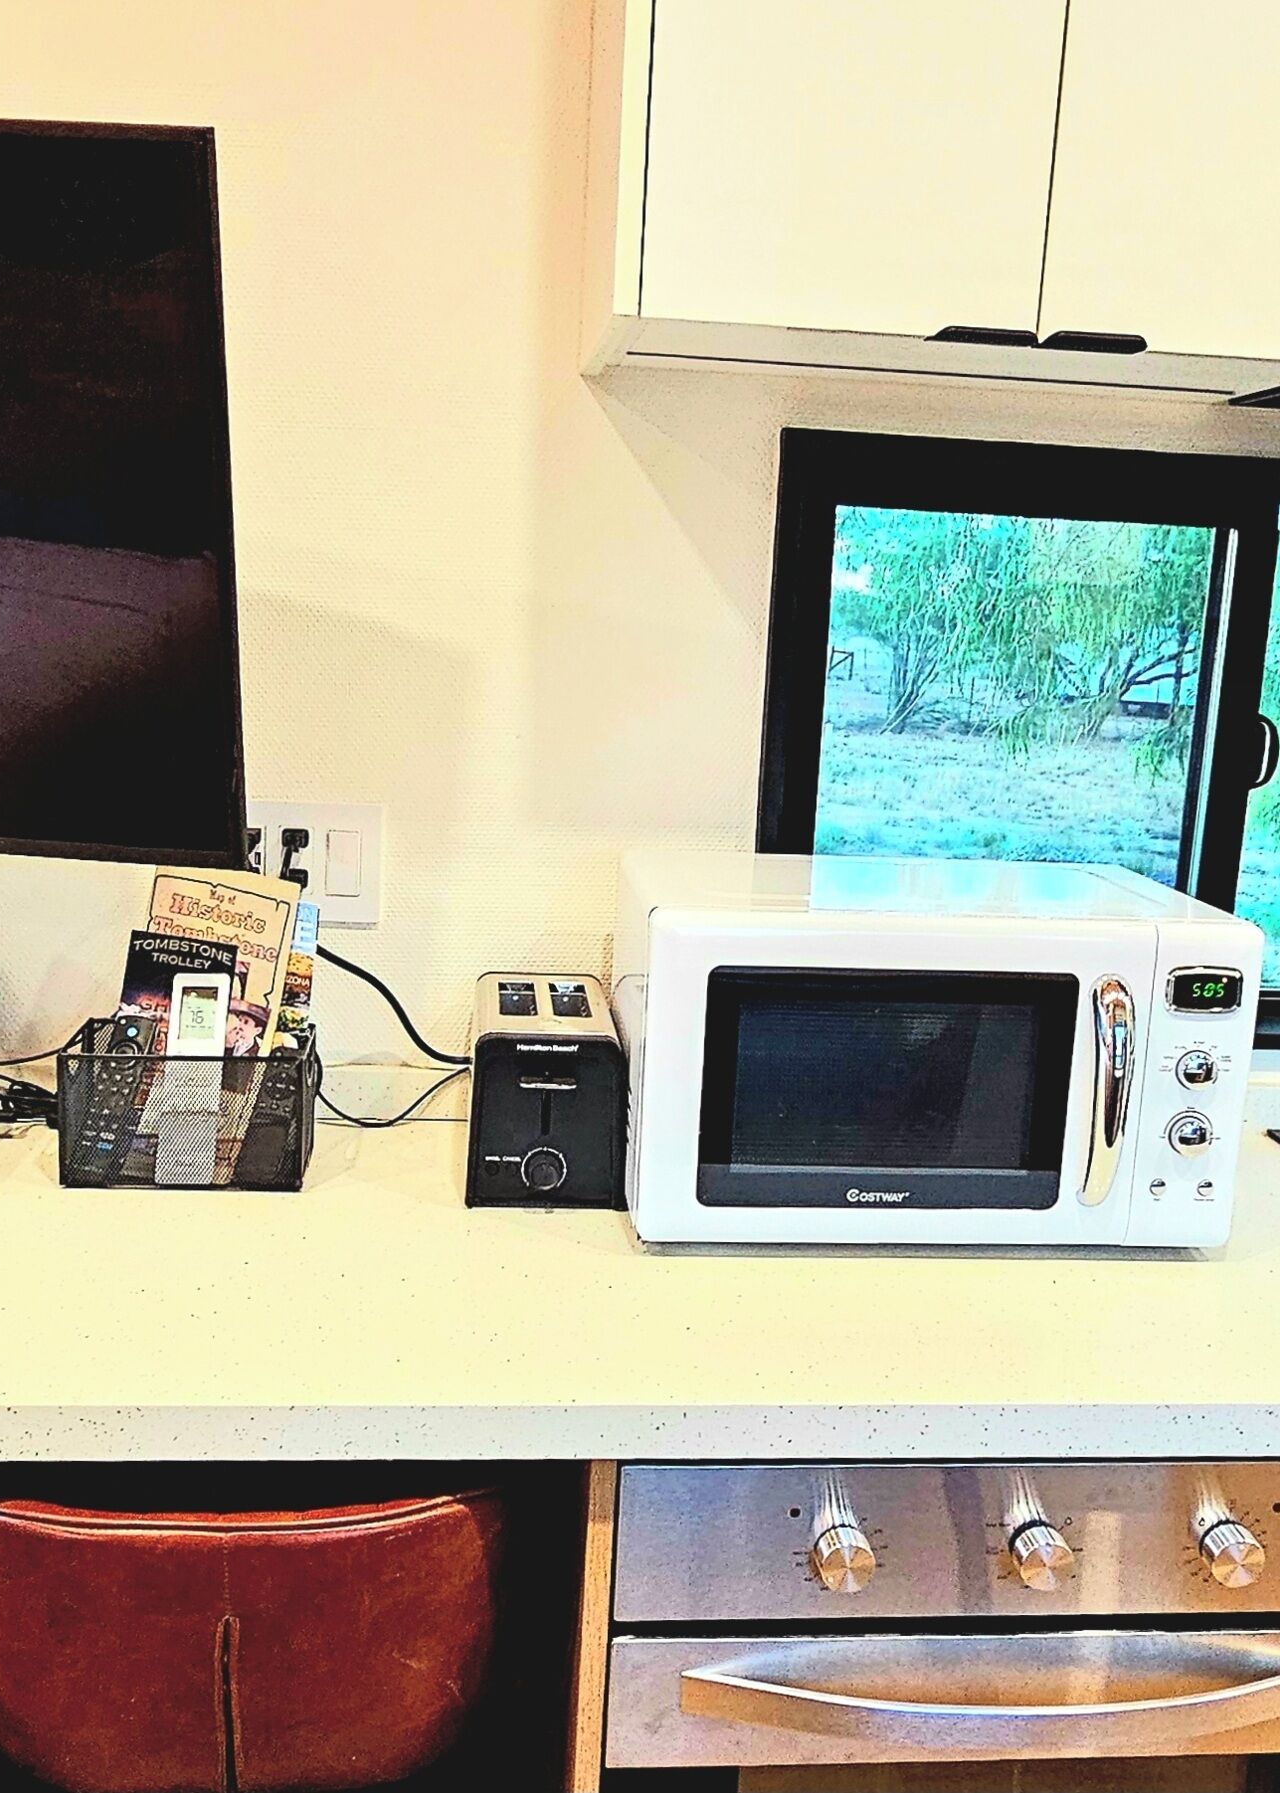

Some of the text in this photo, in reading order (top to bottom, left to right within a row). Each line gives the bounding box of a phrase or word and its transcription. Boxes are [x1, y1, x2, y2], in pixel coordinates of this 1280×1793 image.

[170, 892, 267, 934] Historic
[133, 938, 233, 966] TOMBSTONE
[151, 952, 212, 970] TROLLEY
[846, 1188, 905, 1202] COSTWAY
